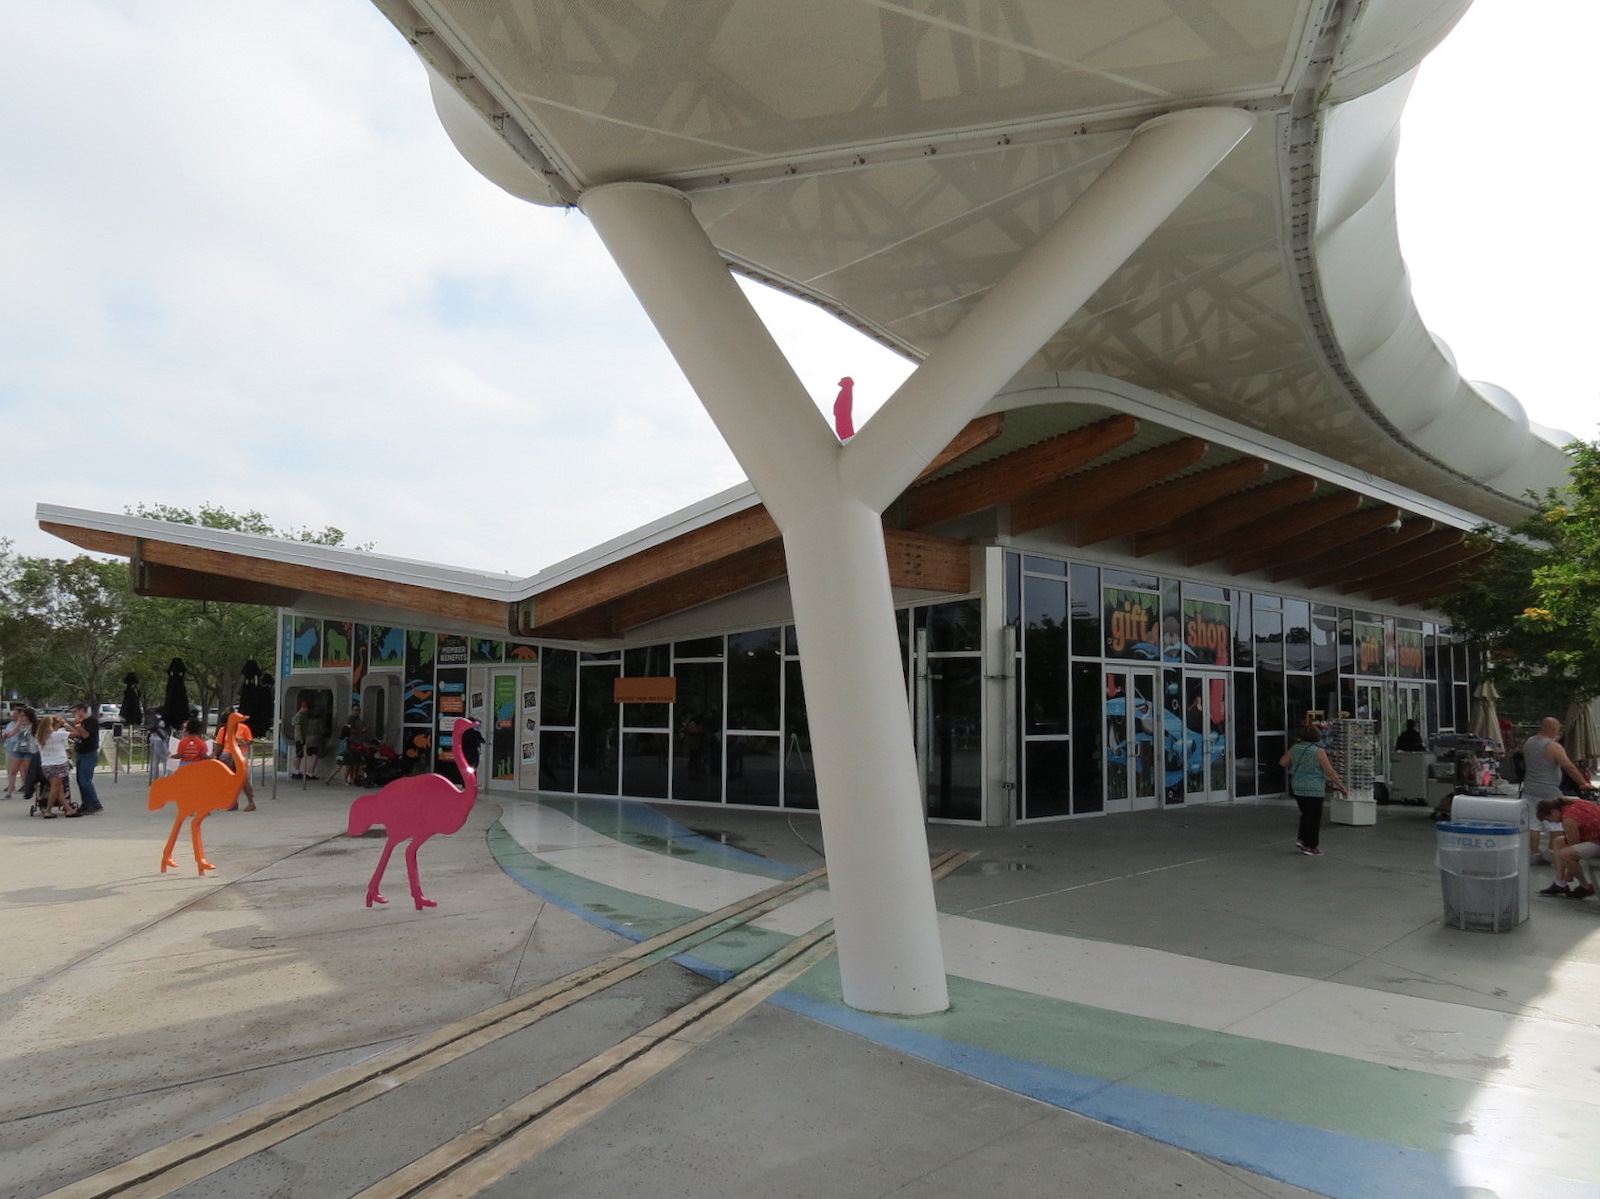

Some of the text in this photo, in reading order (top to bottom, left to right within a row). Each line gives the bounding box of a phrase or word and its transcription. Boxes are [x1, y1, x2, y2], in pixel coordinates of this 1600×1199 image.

[1111, 602, 1228, 655] gift shop
[440, 654, 468, 662] BENEFITS
[441, 645, 467, 654] MEMBER
[1360, 635, 1380, 671] gift
